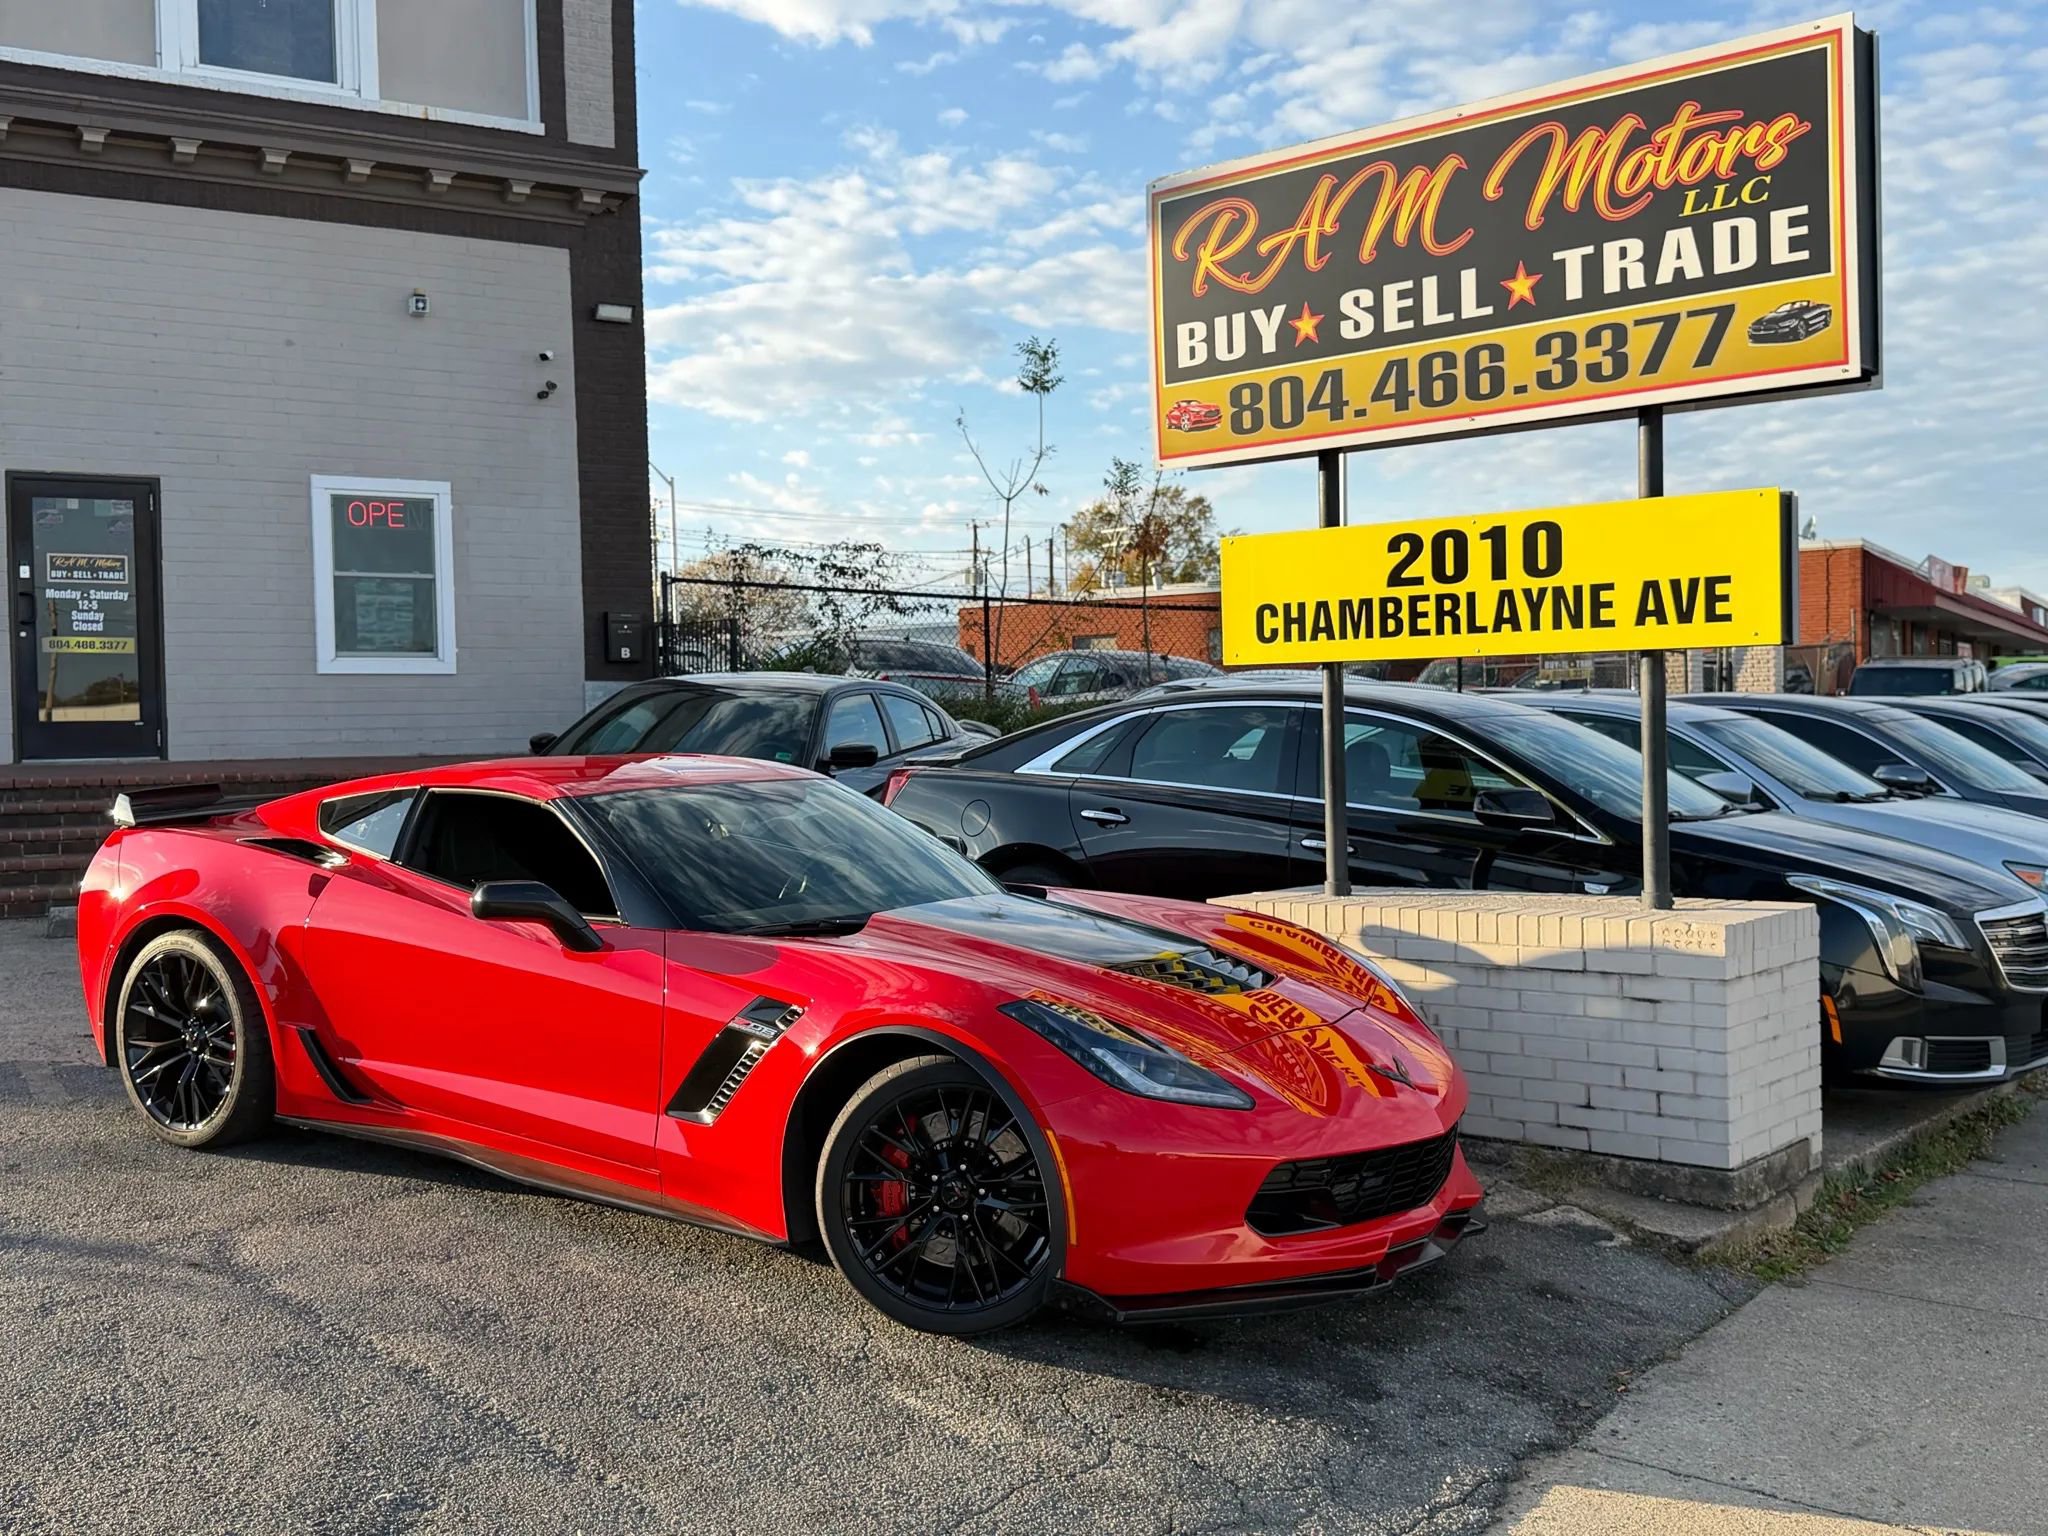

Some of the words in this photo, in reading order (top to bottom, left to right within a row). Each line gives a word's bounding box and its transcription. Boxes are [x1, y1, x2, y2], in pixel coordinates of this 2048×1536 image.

[1172, 154, 1474, 297] RAM
[1483, 101, 1811, 230] Motors
[1678, 176, 1772, 217] LLC
[1177, 304, 1287, 368] BUY
[1339, 268, 1494, 340] SELL
[1552, 205, 1810, 301] TRADE
[1229, 303, 1736, 436] 804.466.3377
[1386, 520, 1563, 588] 2010
[50, 570, 67, 578] BUY
[72, 571, 92, 579] SELL
[98, 571, 125, 580] TRADE
[45, 588, 82, 600] Monday
[89, 589, 129, 601] Saturday
[77, 600, 98, 610] 12-5
[71, 610, 104, 621] Sunday
[1256, 582, 1616, 643] CHAMBERLAYNE
[1634, 575, 1733, 626] AVE
[72, 621, 103, 631] Closed
[621, 647, 631, 659] B
